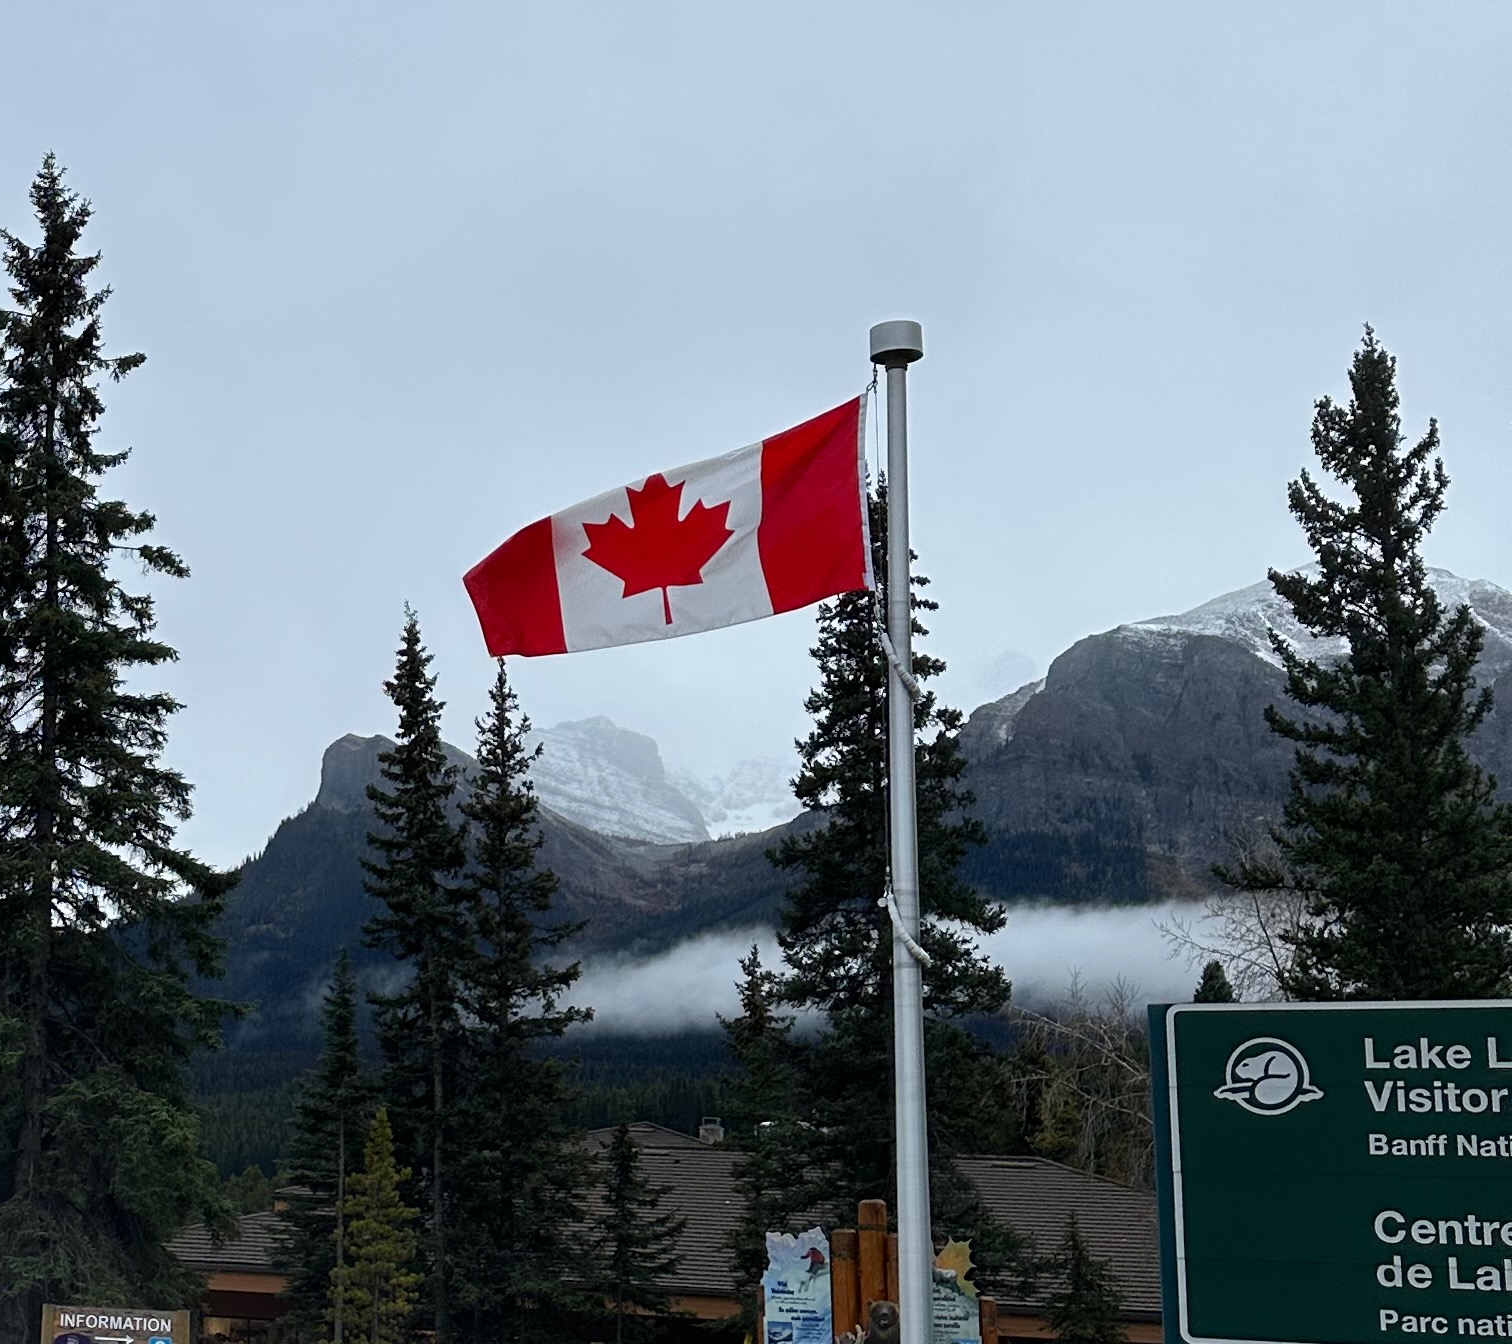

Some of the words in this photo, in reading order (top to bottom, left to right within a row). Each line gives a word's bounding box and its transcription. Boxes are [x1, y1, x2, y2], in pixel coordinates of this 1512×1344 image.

[1364, 1037, 1471, 1069] Lake
[1364, 1080, 1508, 1113] Visitor
[1369, 1133, 1448, 1156] Banff
[1376, 1255, 1433, 1289] de
[59, 1313, 172, 1332] INFORMATION
[1379, 1309, 1449, 1334] Parc
